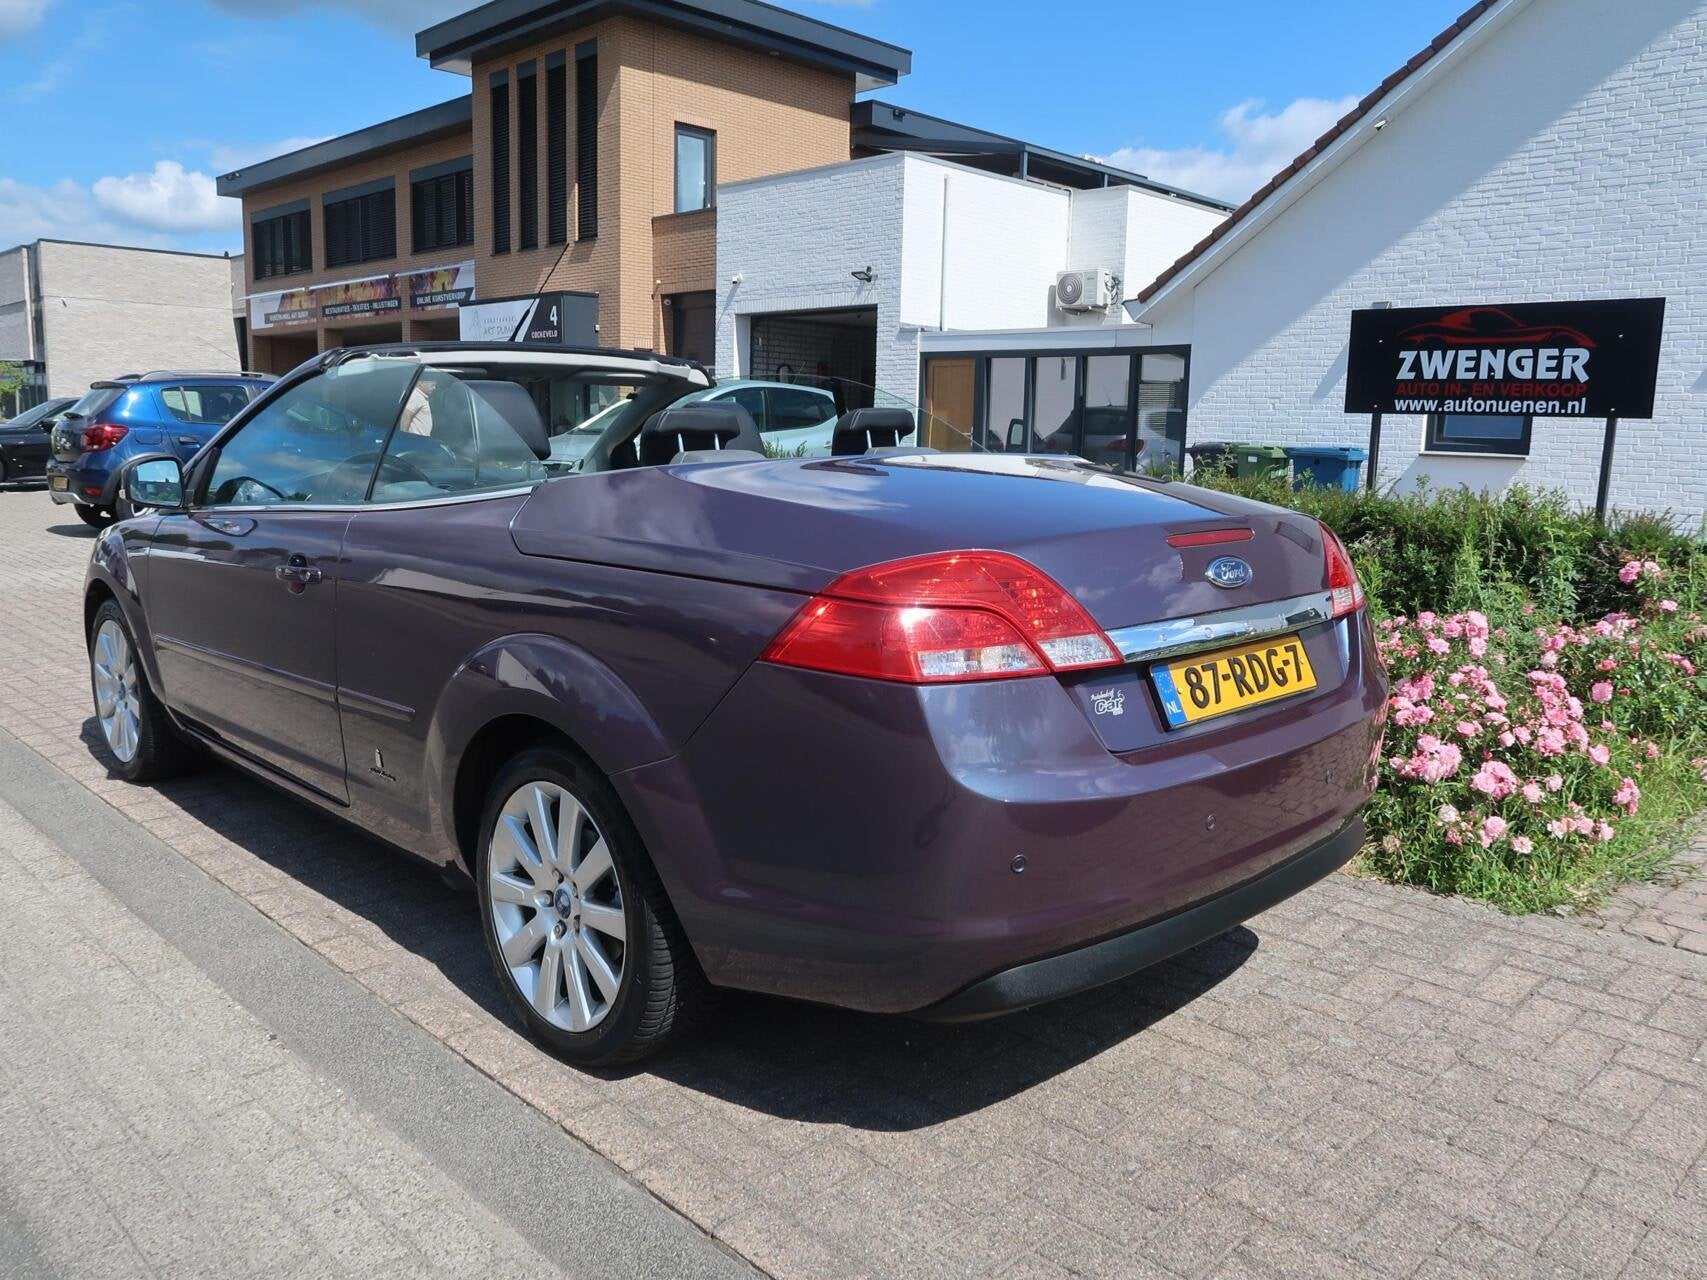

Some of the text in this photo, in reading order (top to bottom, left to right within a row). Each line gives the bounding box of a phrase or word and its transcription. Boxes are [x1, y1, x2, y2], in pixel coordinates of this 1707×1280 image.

[550, 305, 557, 326] 4
[1396, 348, 1590, 383] ZWENGER
[1396, 382, 1588, 397] AUTO IN- EN VERKOOP
[1394, 397, 1587, 414] www.autonuenen.nl
[1221, 562, 1245, 580] Ford
[1184, 644, 1304, 709] 87-RDG-7
[1165, 701, 1182, 714] NL
